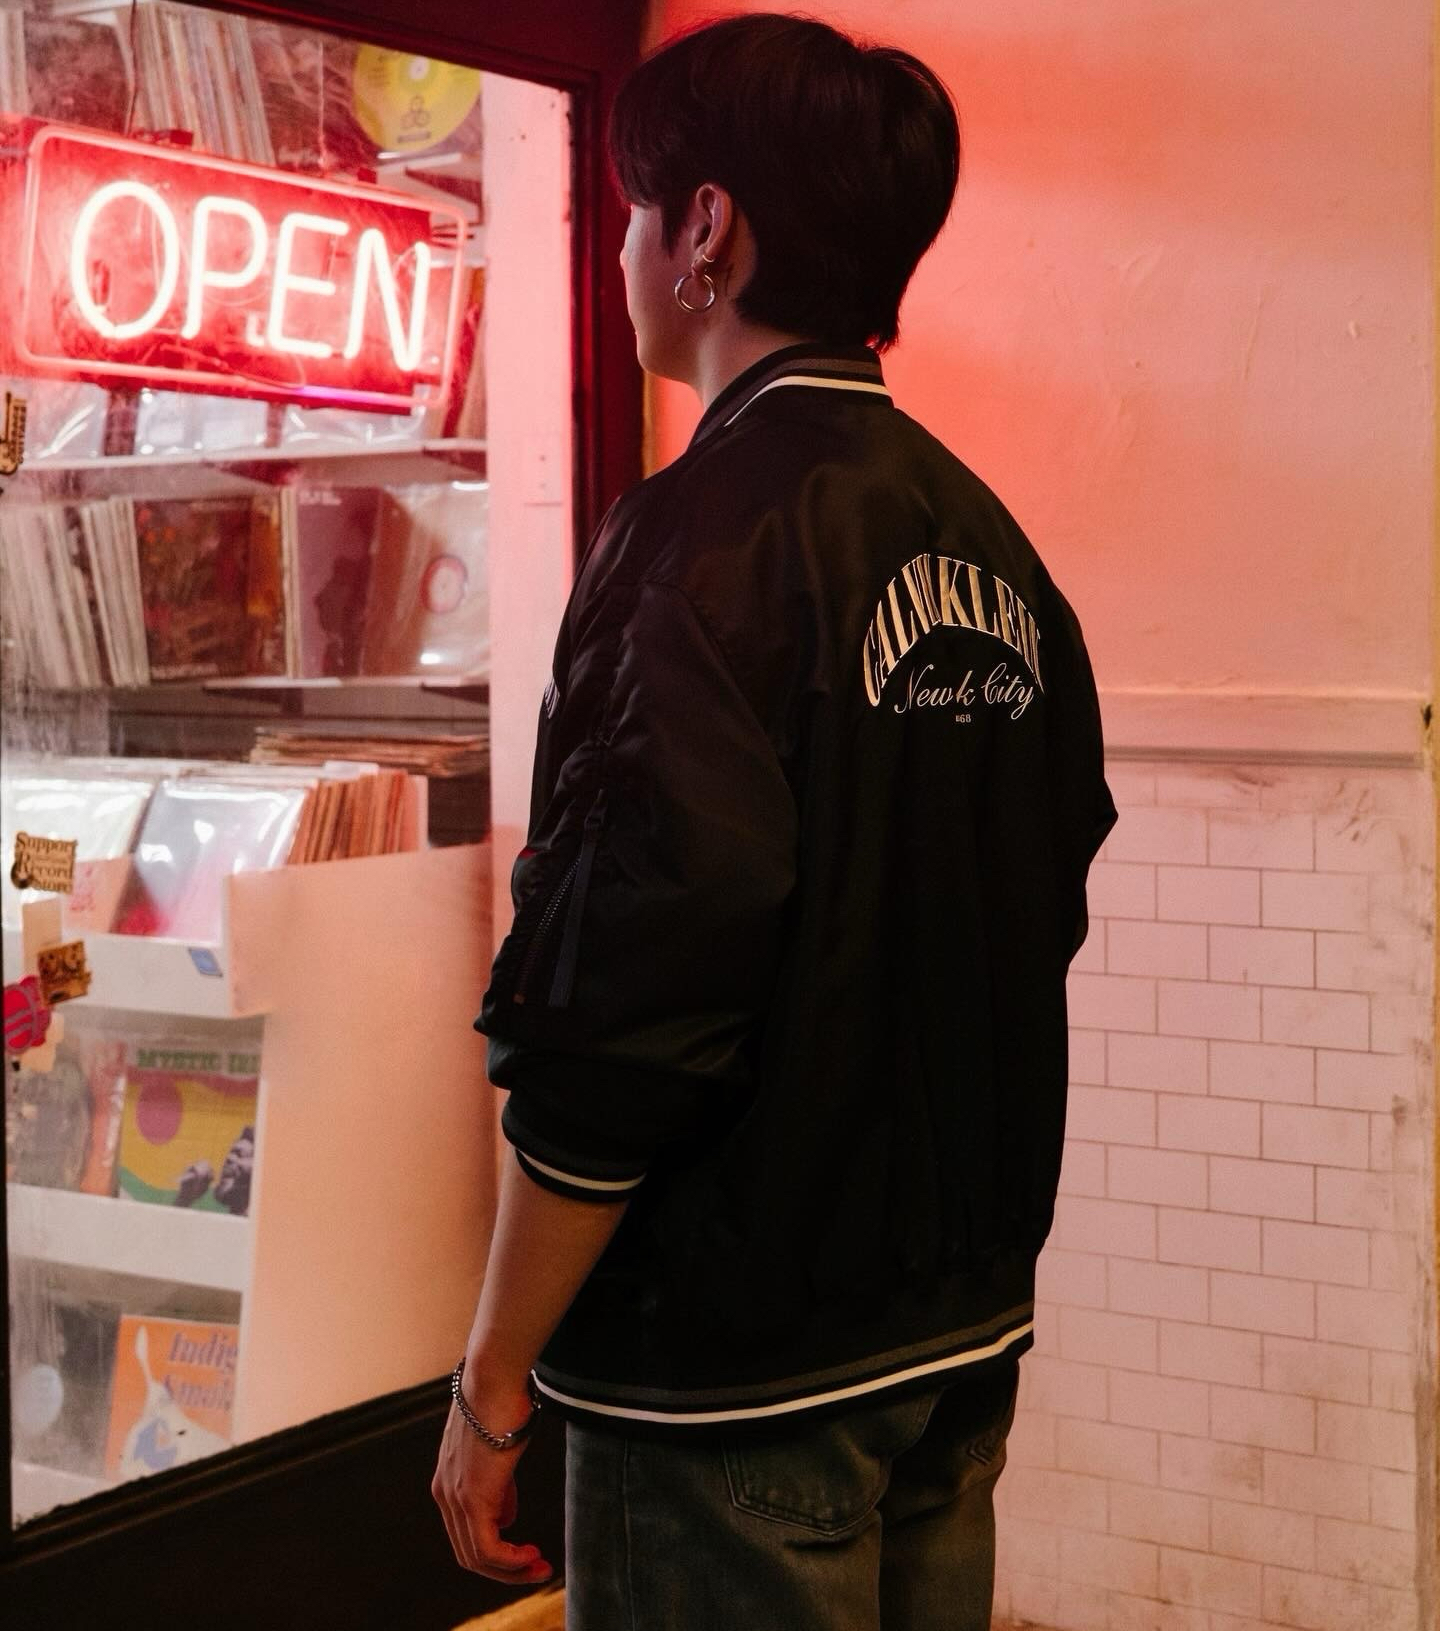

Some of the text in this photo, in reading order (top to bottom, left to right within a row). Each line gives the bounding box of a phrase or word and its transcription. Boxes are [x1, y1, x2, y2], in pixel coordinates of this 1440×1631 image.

[71, 180, 431, 371] OPEN
[980, 662, 1034, 720] City
[16, 831, 78, 853] Support
[18, 852, 74, 879] Record
